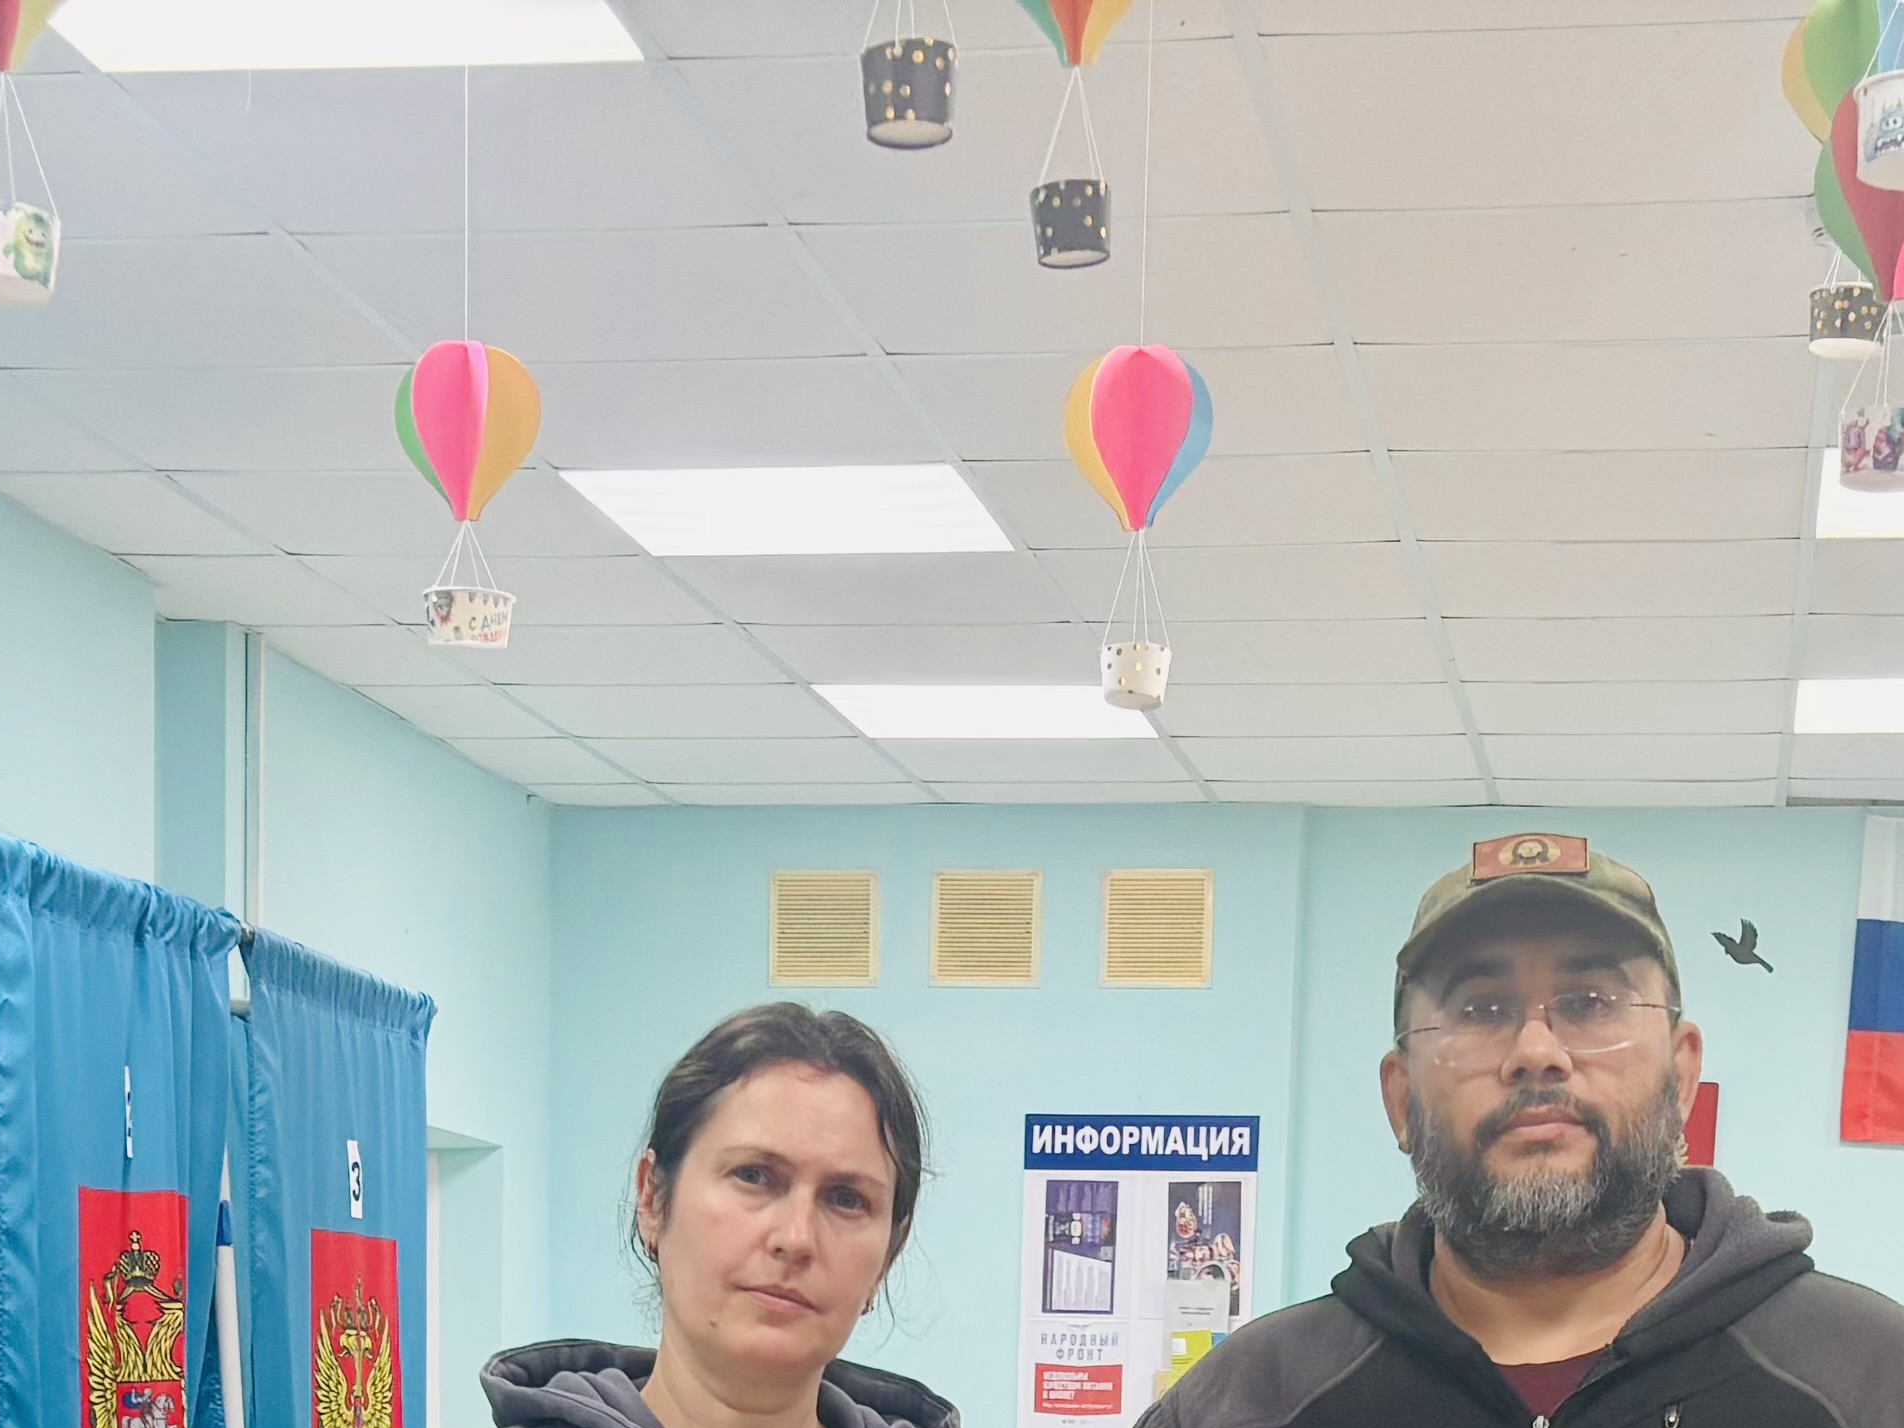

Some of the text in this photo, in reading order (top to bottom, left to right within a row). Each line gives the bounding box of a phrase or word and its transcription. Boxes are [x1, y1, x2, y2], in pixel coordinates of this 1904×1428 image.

[1032, 1124, 1251, 1161] ИНФОРМАЦИЯ
[351, 1161, 361, 1201] 3
[1041, 1331, 1119, 1347] НАРОДНЫЙ
[1056, 1348, 1103, 1361] ФРОНТ
